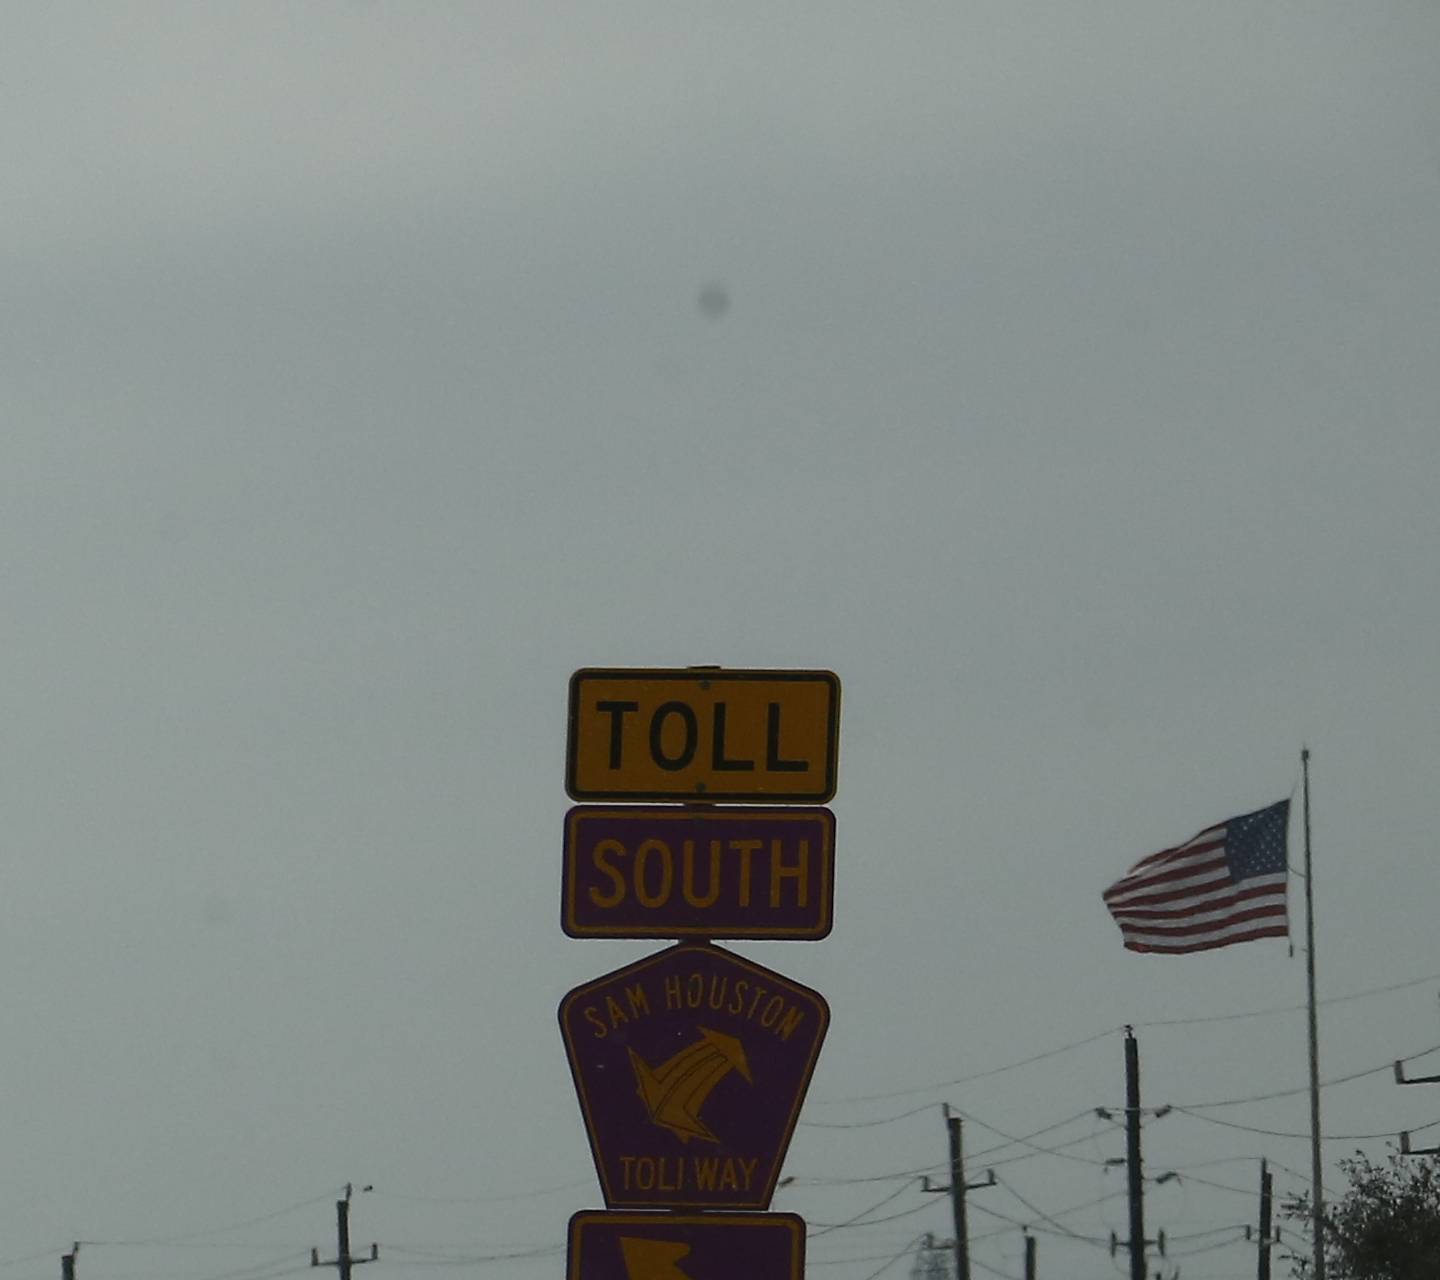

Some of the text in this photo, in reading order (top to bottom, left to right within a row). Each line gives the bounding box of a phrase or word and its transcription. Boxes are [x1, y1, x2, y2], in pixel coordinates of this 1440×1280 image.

[597, 702, 809, 772] TOLL
[589, 839, 809, 908] SOUTH
[584, 974, 806, 1041] SAM HOUSTON
